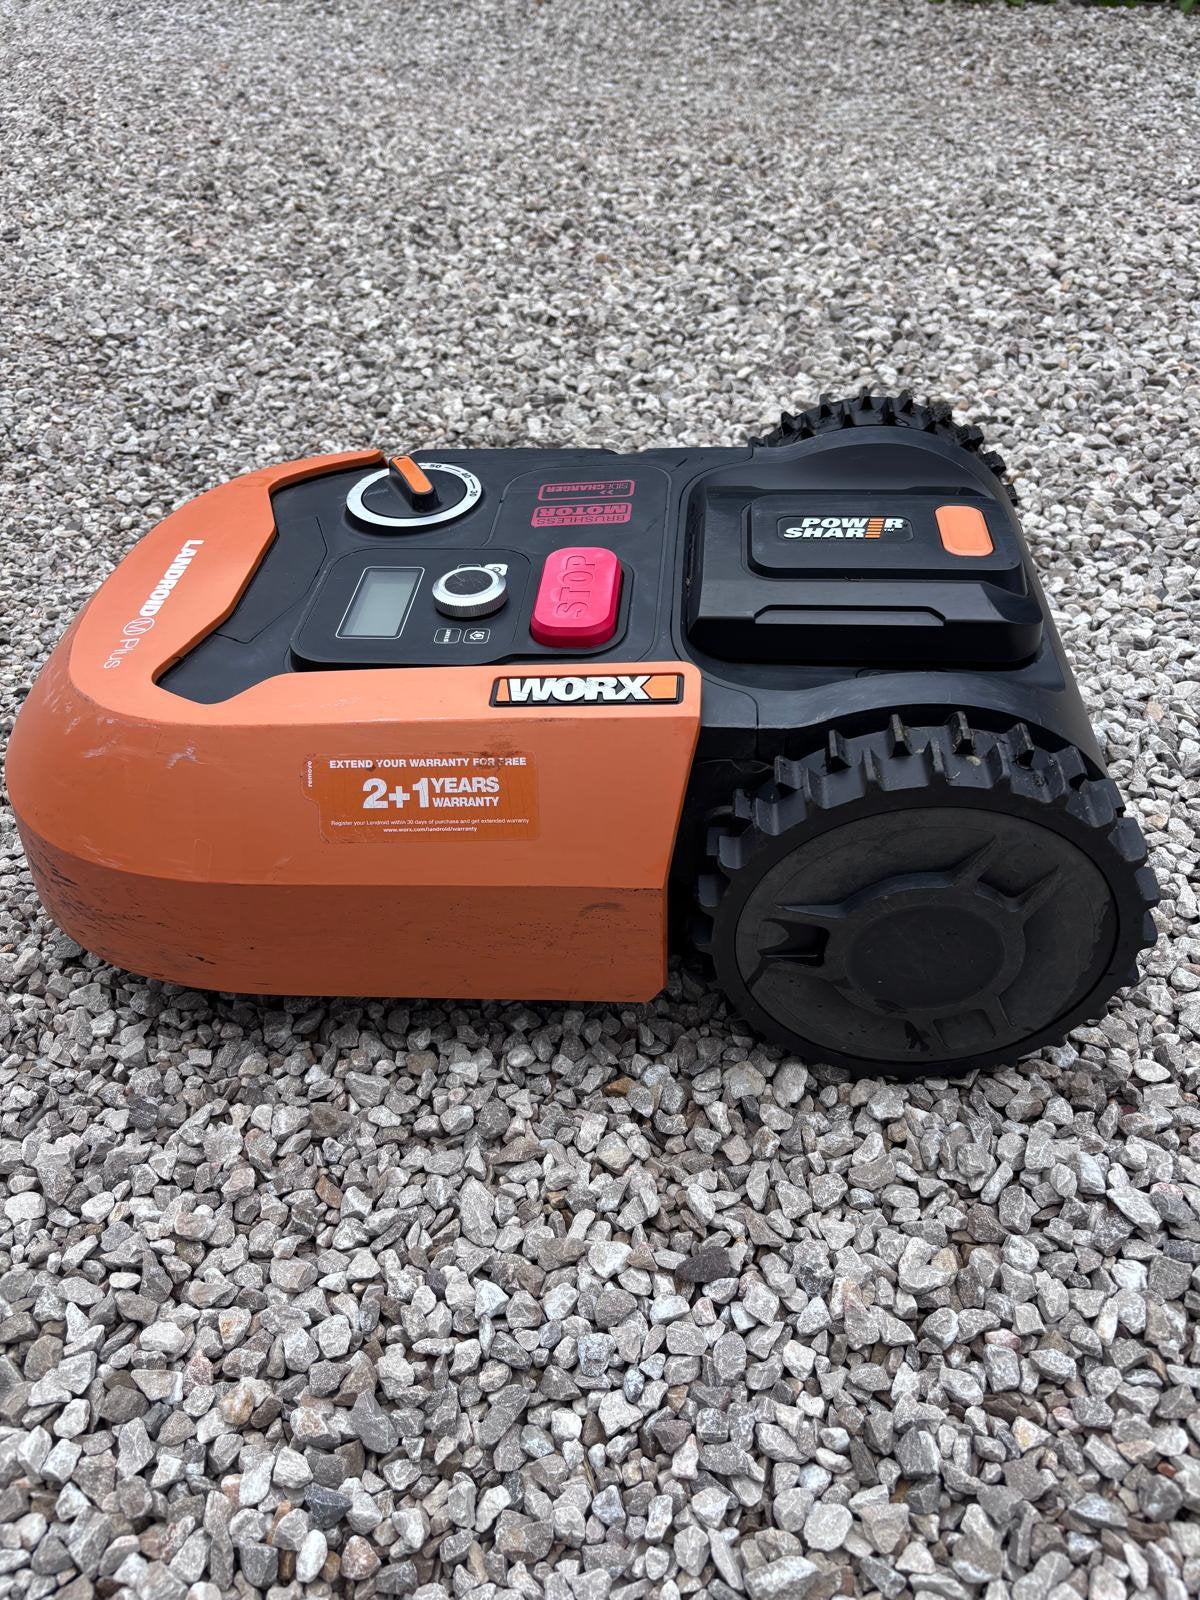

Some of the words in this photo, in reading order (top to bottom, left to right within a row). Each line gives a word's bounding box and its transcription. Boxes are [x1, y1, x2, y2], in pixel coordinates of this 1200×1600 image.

[546, 484, 606, 493] CHARGER
[536, 515, 625, 525] BRUSHLESS
[539, 505, 627, 517] MOTOR
[139, 539, 205, 617] LANDROID
[555, 555, 596, 618] STOP
[103, 638, 141, 669] Plus
[508, 675, 651, 702] WORX
[329, 759, 374, 769] EXTEND
[376, 759, 407, 768] YOUR
[409, 757, 470, 768] WARRANTY
[472, 757, 495, 767] FOR
[362, 777, 430, 809] 2+1
[430, 776, 500, 794] YEARS
[432, 796, 500, 808] WARRANTY
